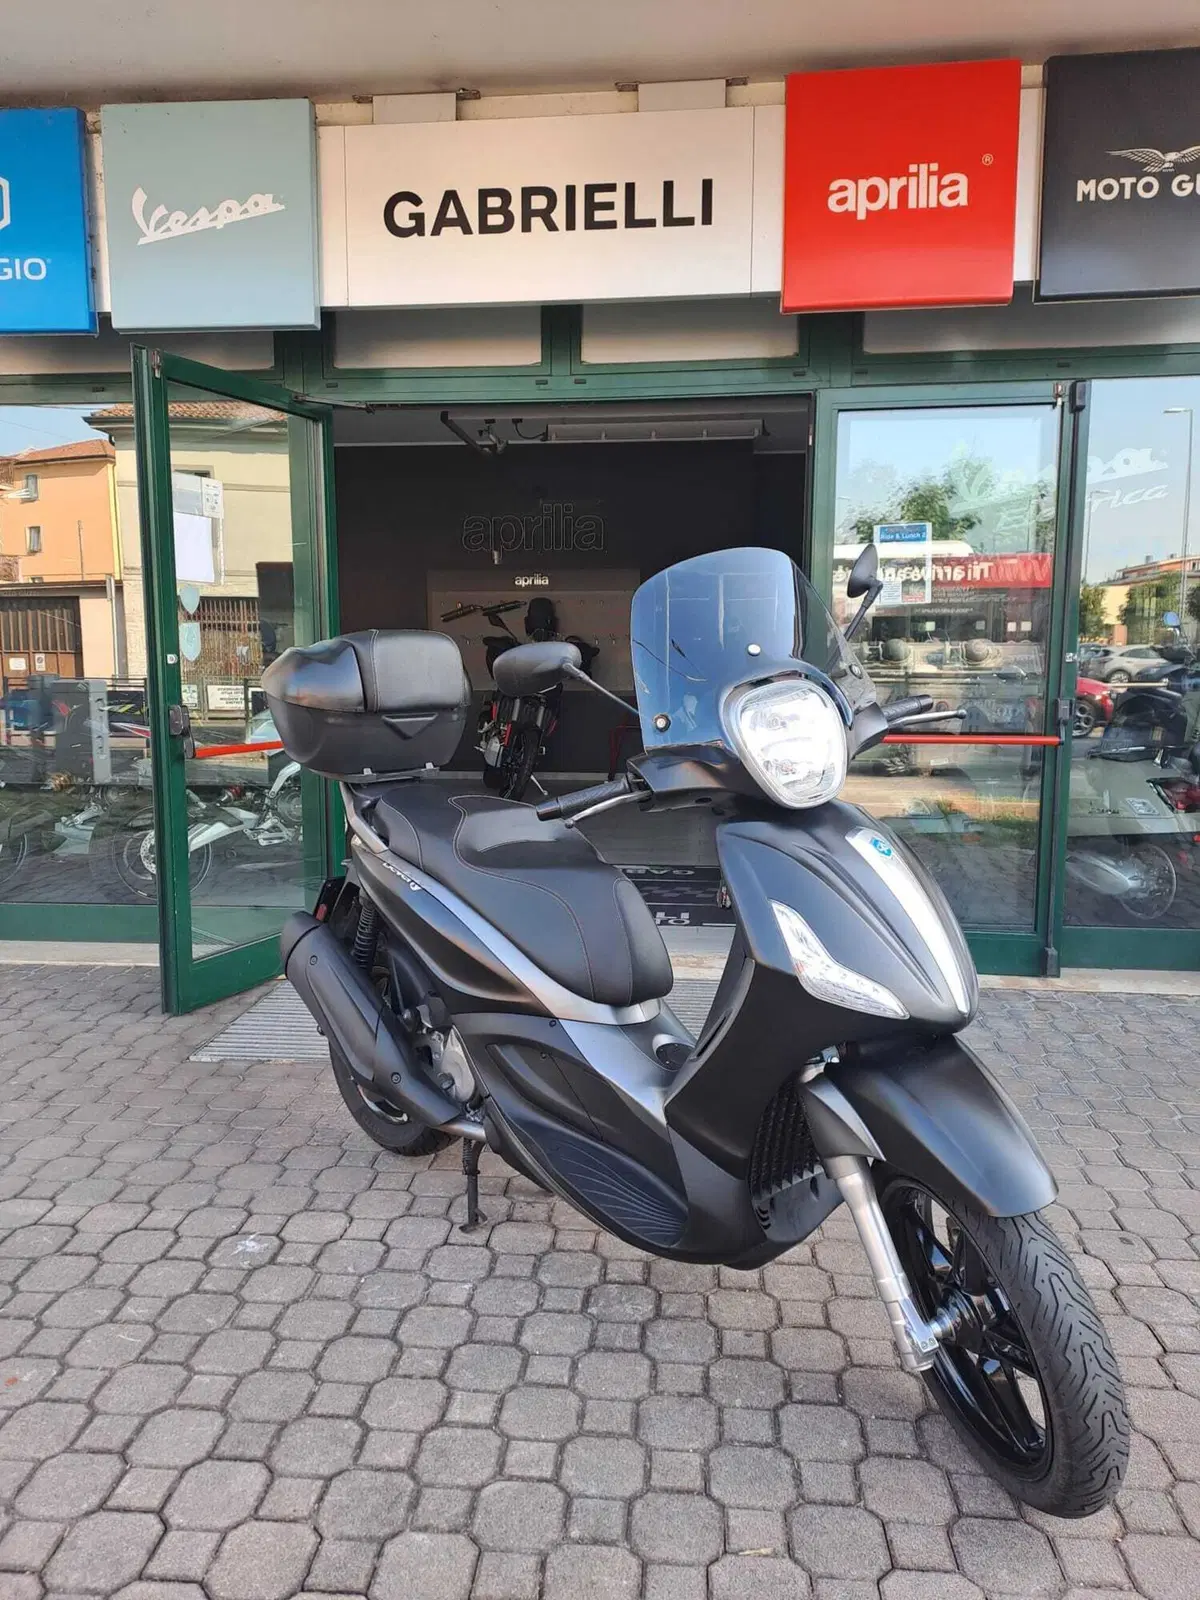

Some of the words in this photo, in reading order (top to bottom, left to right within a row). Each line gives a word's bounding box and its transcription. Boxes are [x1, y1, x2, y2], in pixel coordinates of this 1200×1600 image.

[131, 186, 286, 246] Vespa
[383, 178, 713, 239] GABRIELLI
[827, 163, 969, 221] aprilia
[1076, 175, 1160, 202] MOTO
[1171, 173, 1200, 198] G
[461, 502, 605, 562] aprilia
[514, 572, 549, 588] aprilia
